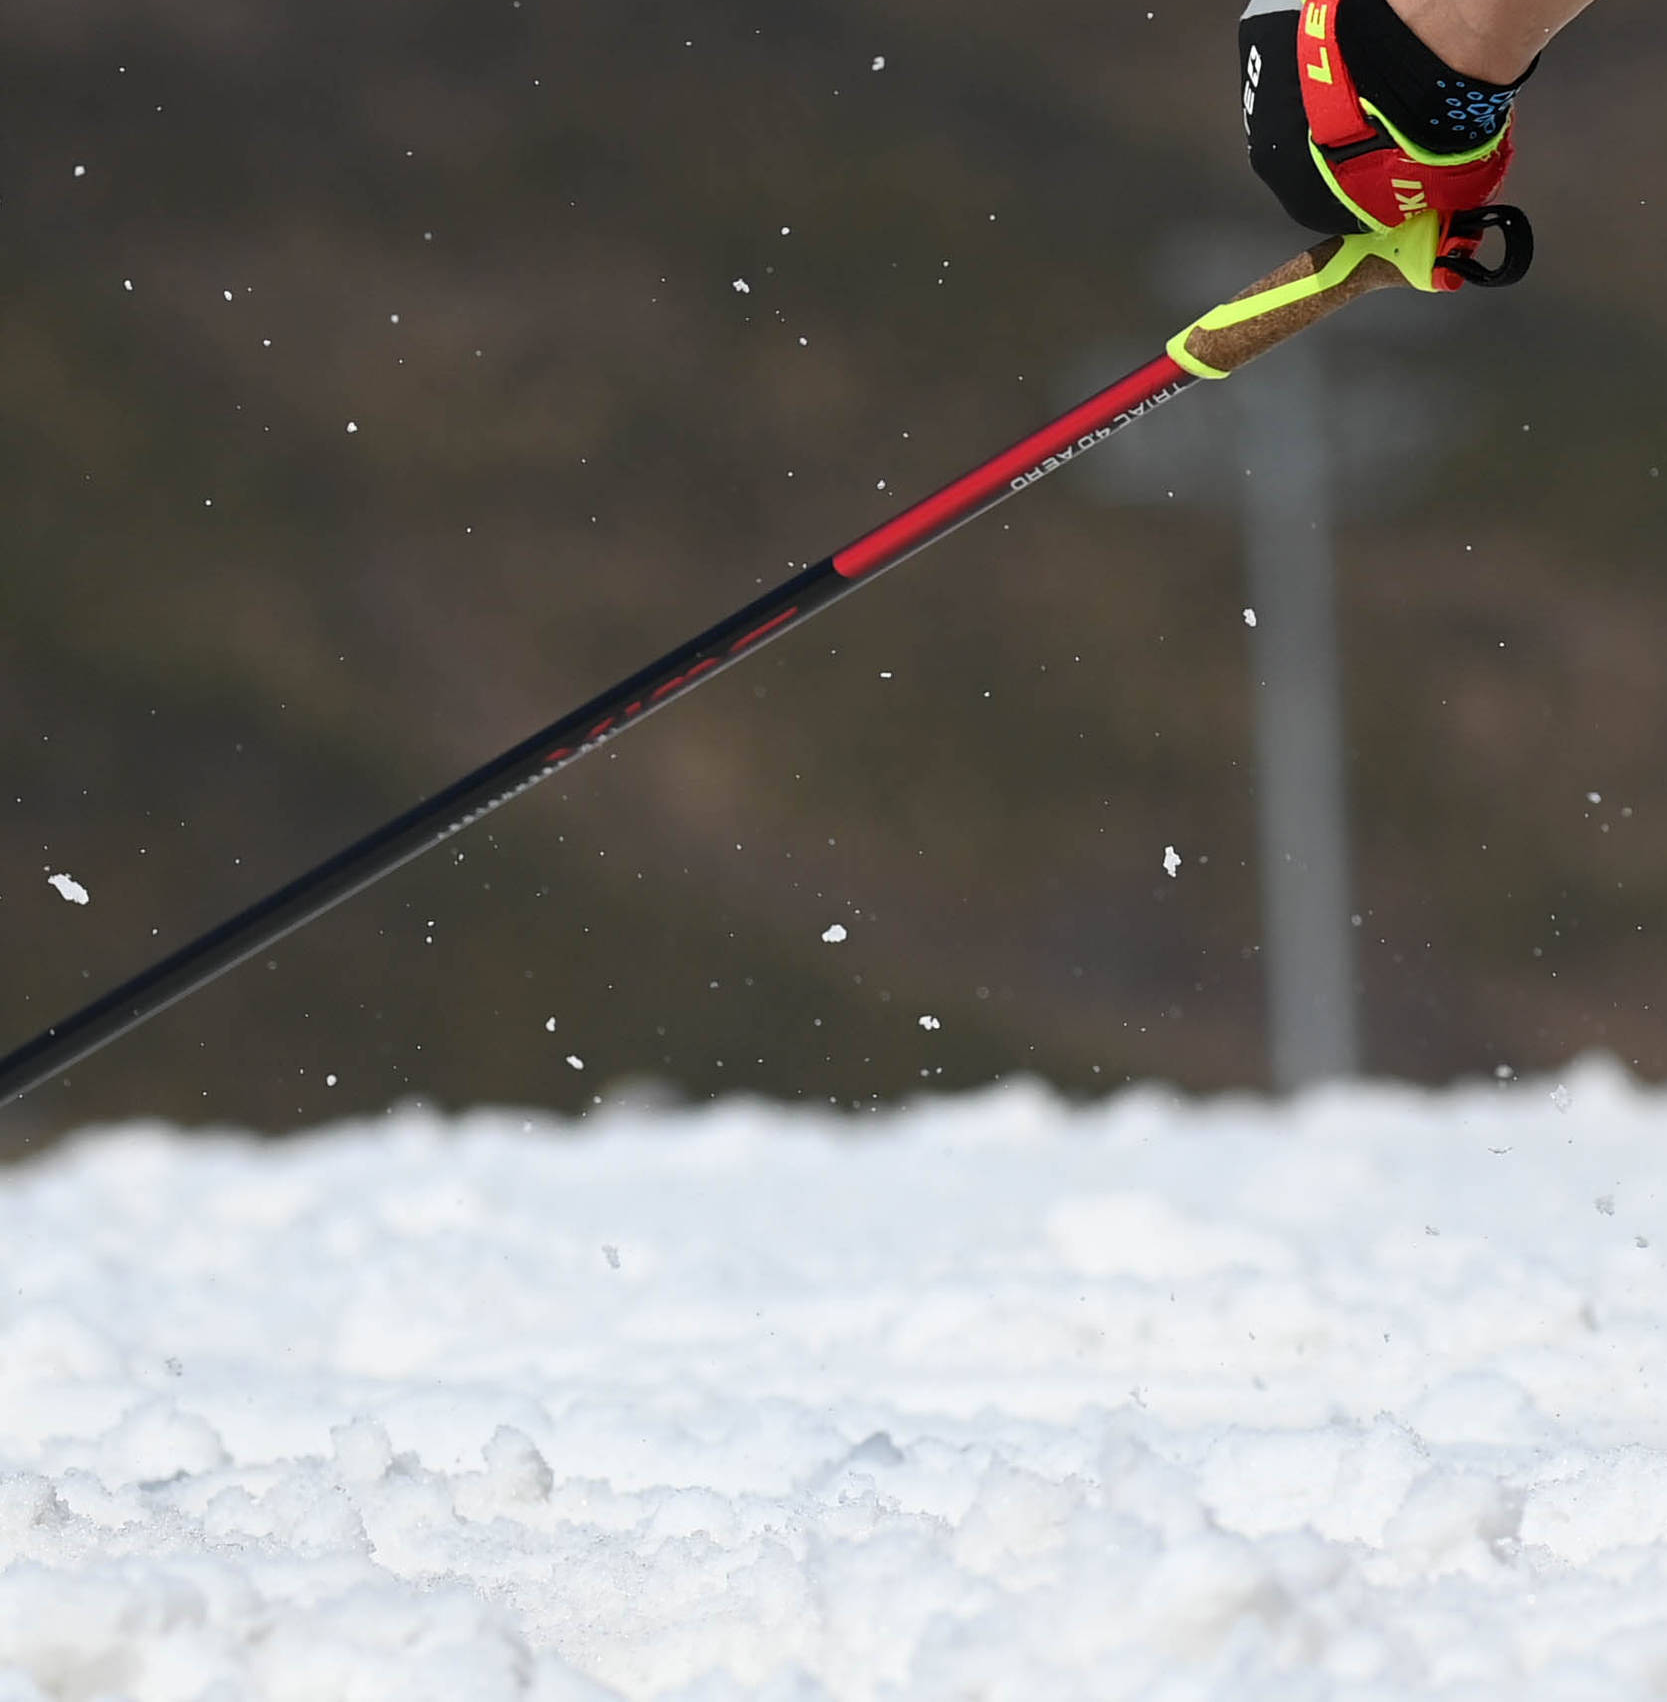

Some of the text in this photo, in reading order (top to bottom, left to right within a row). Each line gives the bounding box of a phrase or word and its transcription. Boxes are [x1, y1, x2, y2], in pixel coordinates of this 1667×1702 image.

[1390, 177, 1430, 221] KI
[1009, 381, 1186, 492] TRIAC 4.0 AERO
